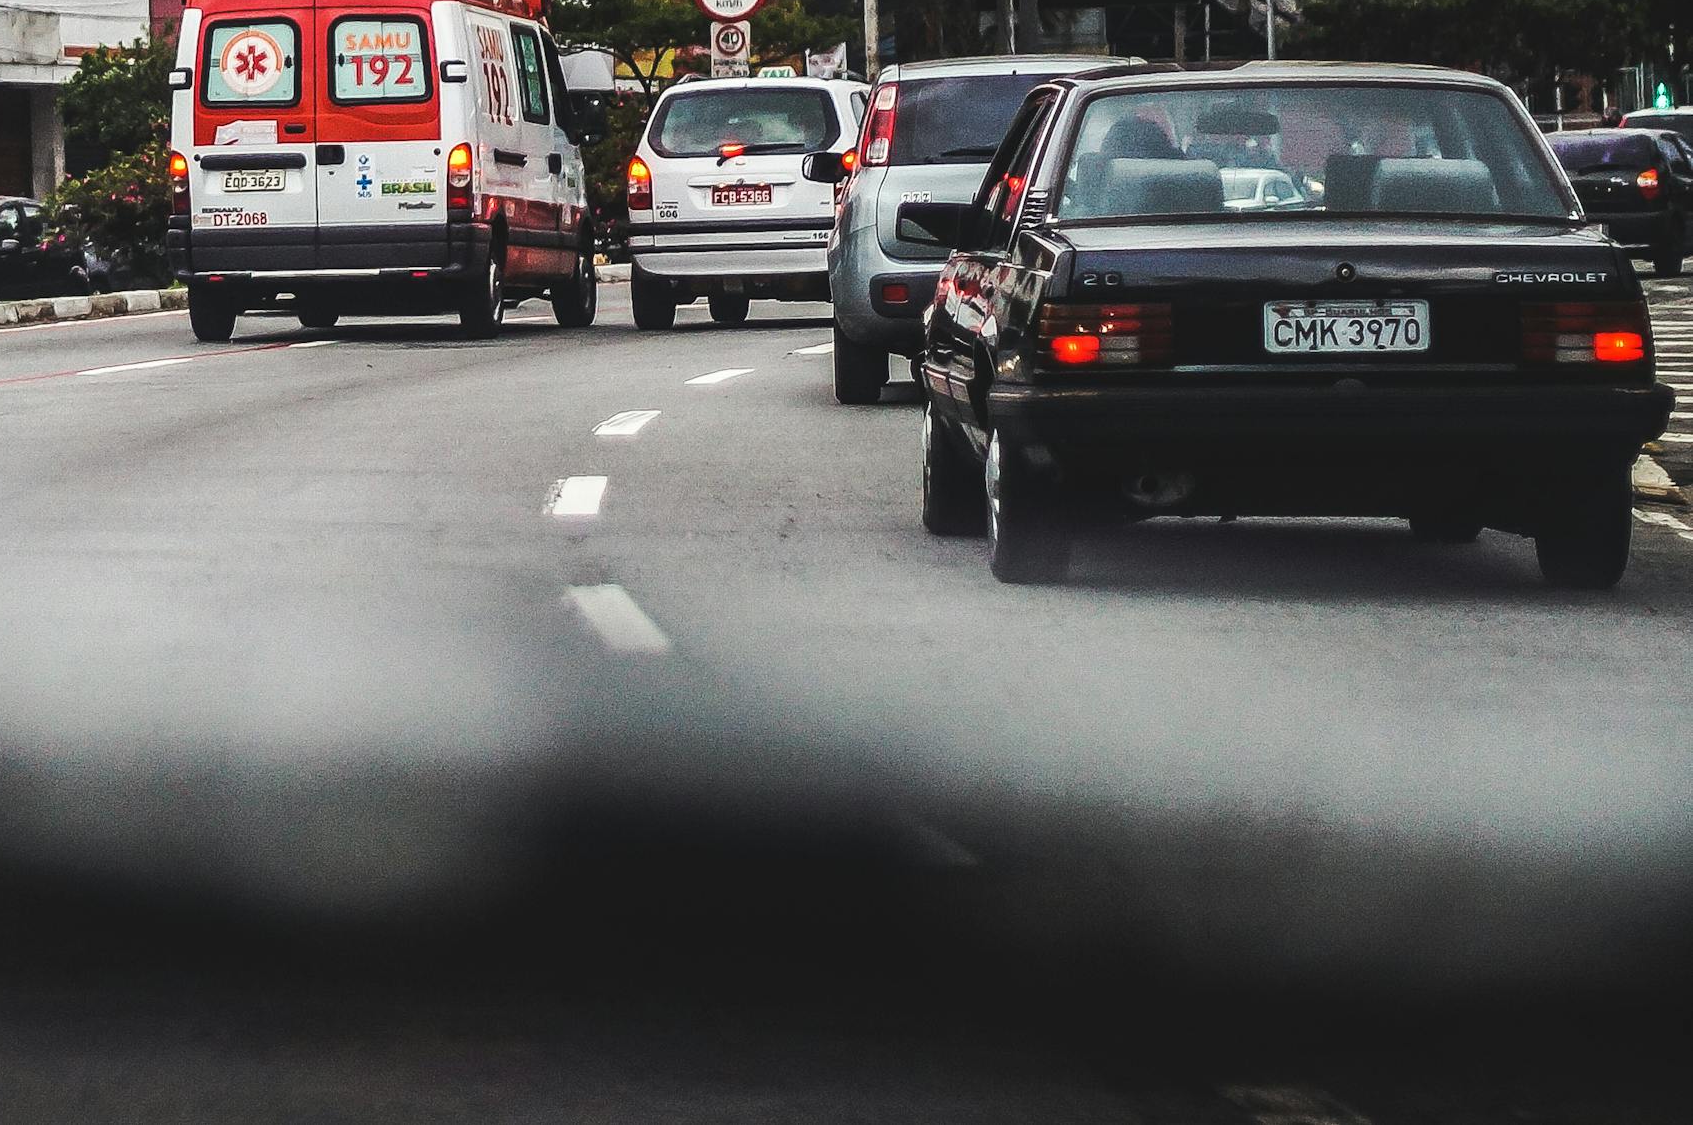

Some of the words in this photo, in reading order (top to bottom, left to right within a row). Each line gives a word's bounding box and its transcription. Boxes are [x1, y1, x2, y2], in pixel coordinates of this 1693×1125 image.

[345, 31, 411, 51] SAMU
[476, 24, 504, 63] SAMU
[350, 55, 415, 86] 192
[762, 68, 791, 77] TAXI
[483, 62, 514, 127] 192
[381, 182, 437, 194] BRASIL
[213, 212, 267, 226] DT-2068
[1495, 272, 1607, 283] CHEVROLET
